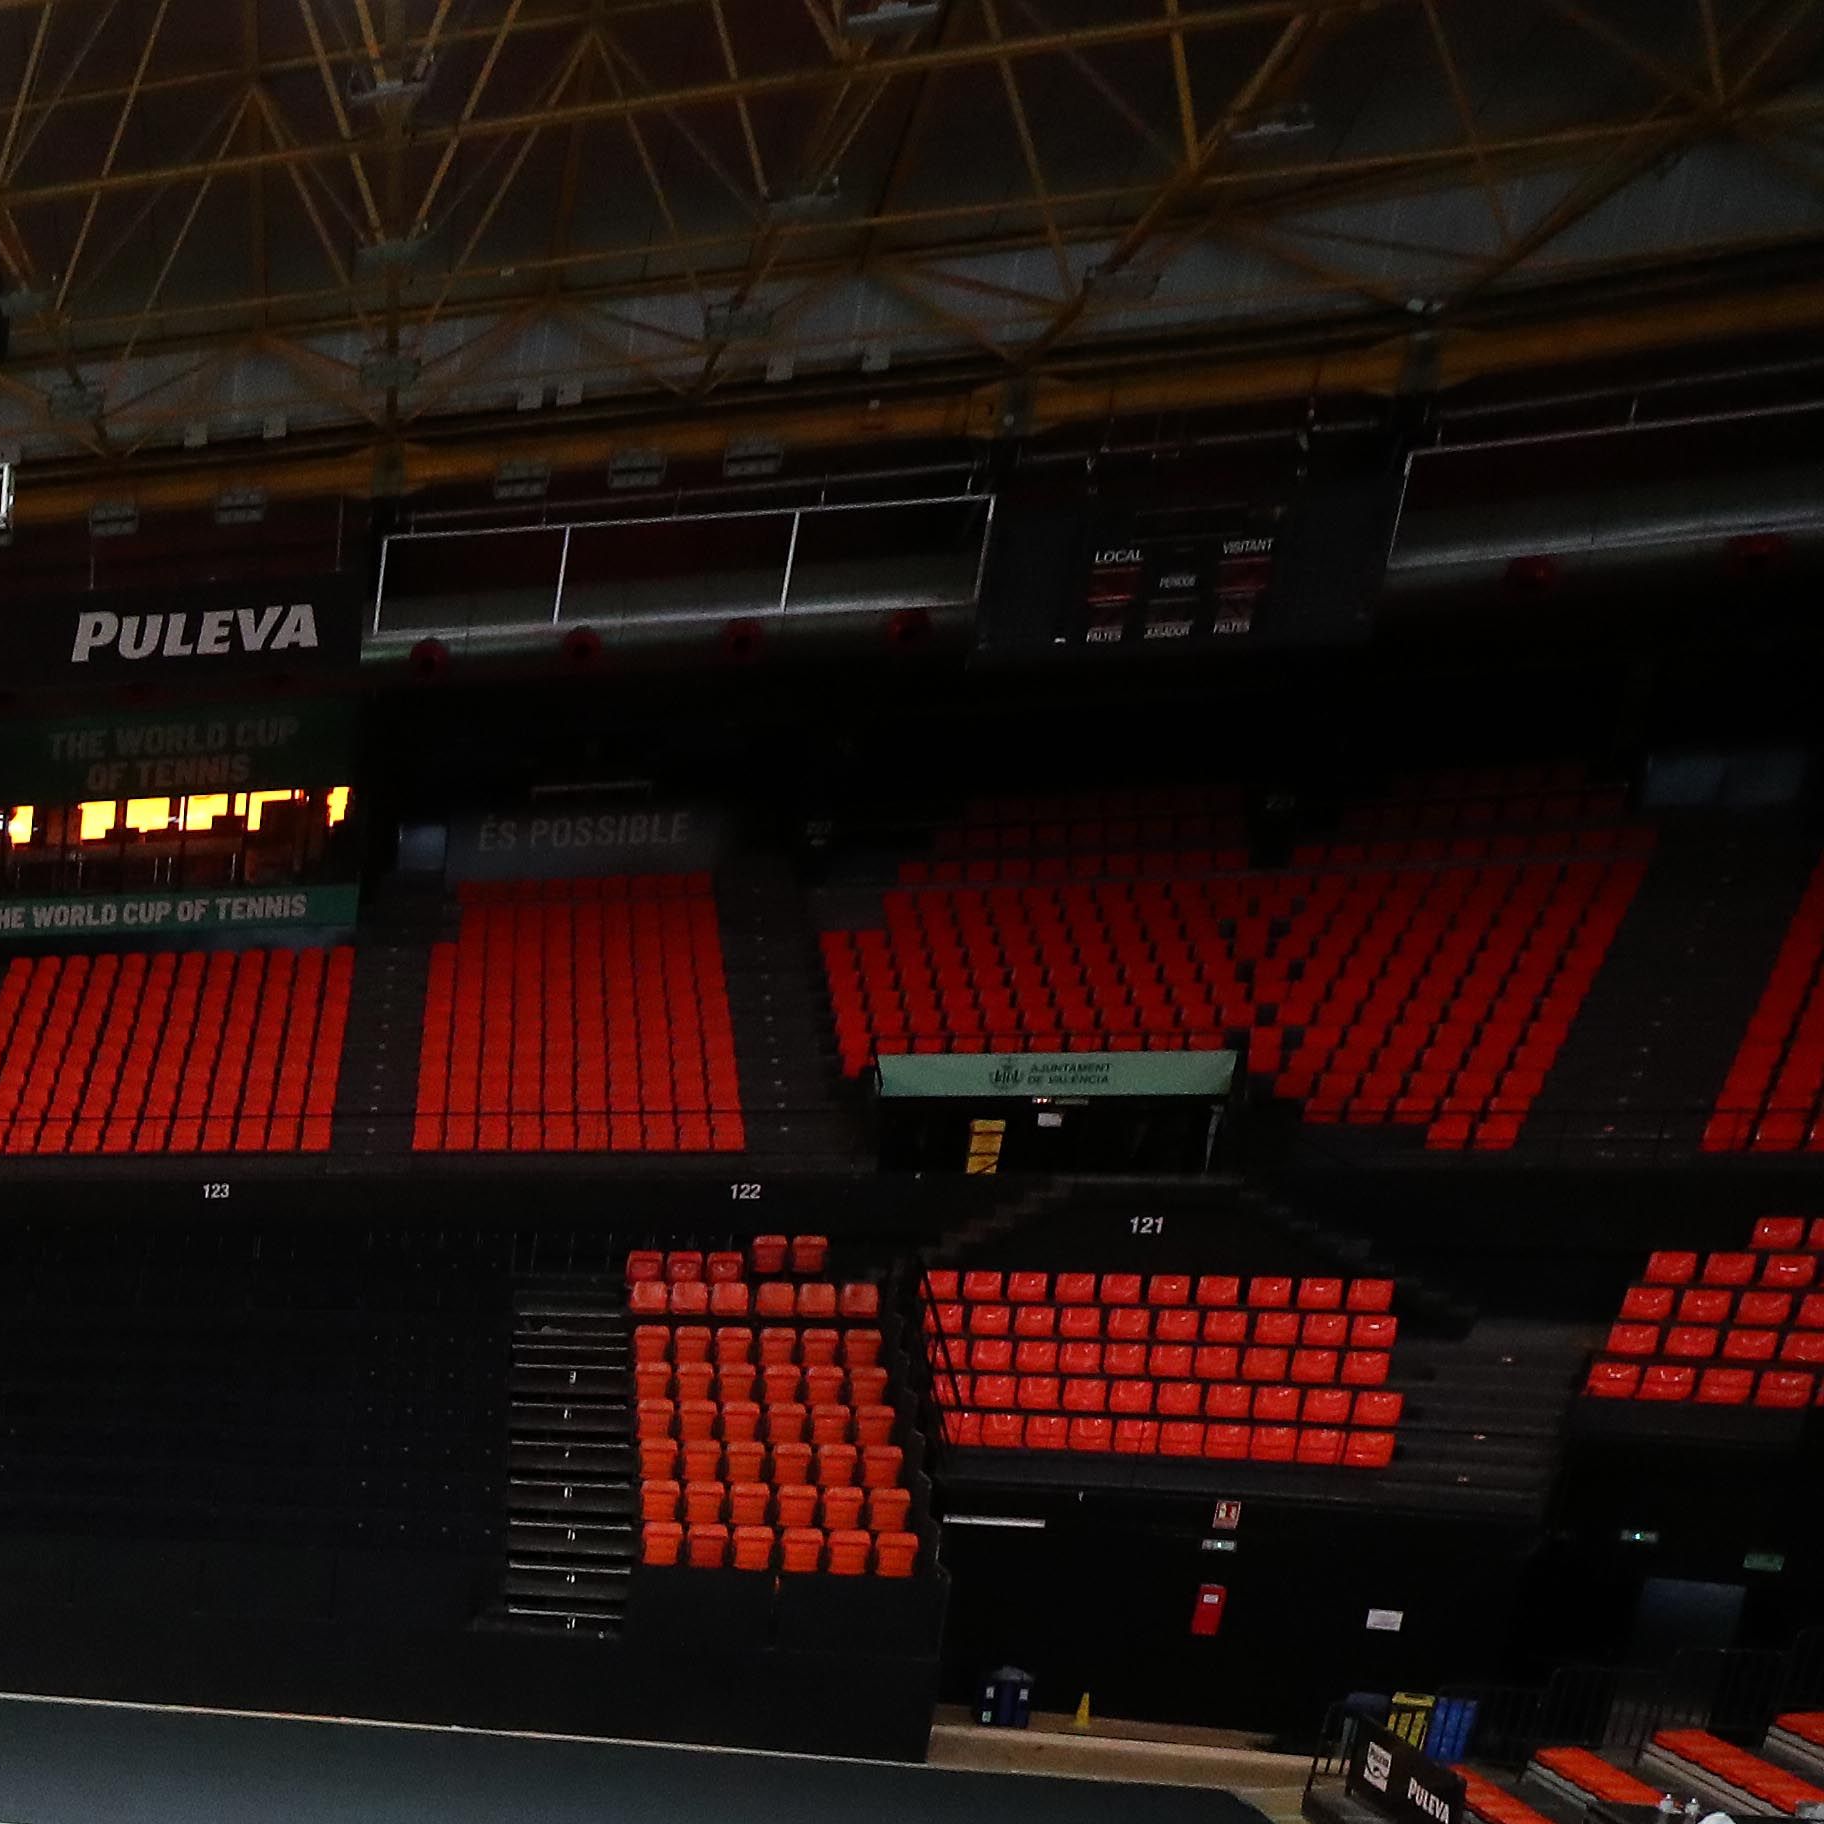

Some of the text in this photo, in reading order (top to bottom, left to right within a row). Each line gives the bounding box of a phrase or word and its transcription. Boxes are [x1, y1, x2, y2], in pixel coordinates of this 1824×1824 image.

[1095, 548, 1144, 563] LOCAL
[1222, 538, 1274, 555] VISITANT
[71, 603, 320, 663] PULEVA
[50, 714, 300, 761] THE WORLD CUP
[87, 754, 251, 792] OF TENNIS
[529, 812, 690, 848] POSSIBLE
[33, 901, 119, 929] WORLD
[124, 898, 171, 925] CUP
[178, 897, 209, 922] OF
[214, 894, 307, 921] TENNIS
[1030, 1062, 1112, 1074] AJUNTAMENT
[202, 1183, 231, 1200] 123
[729, 1183, 762, 1200] 122
[1129, 1215, 1165, 1237] 121
